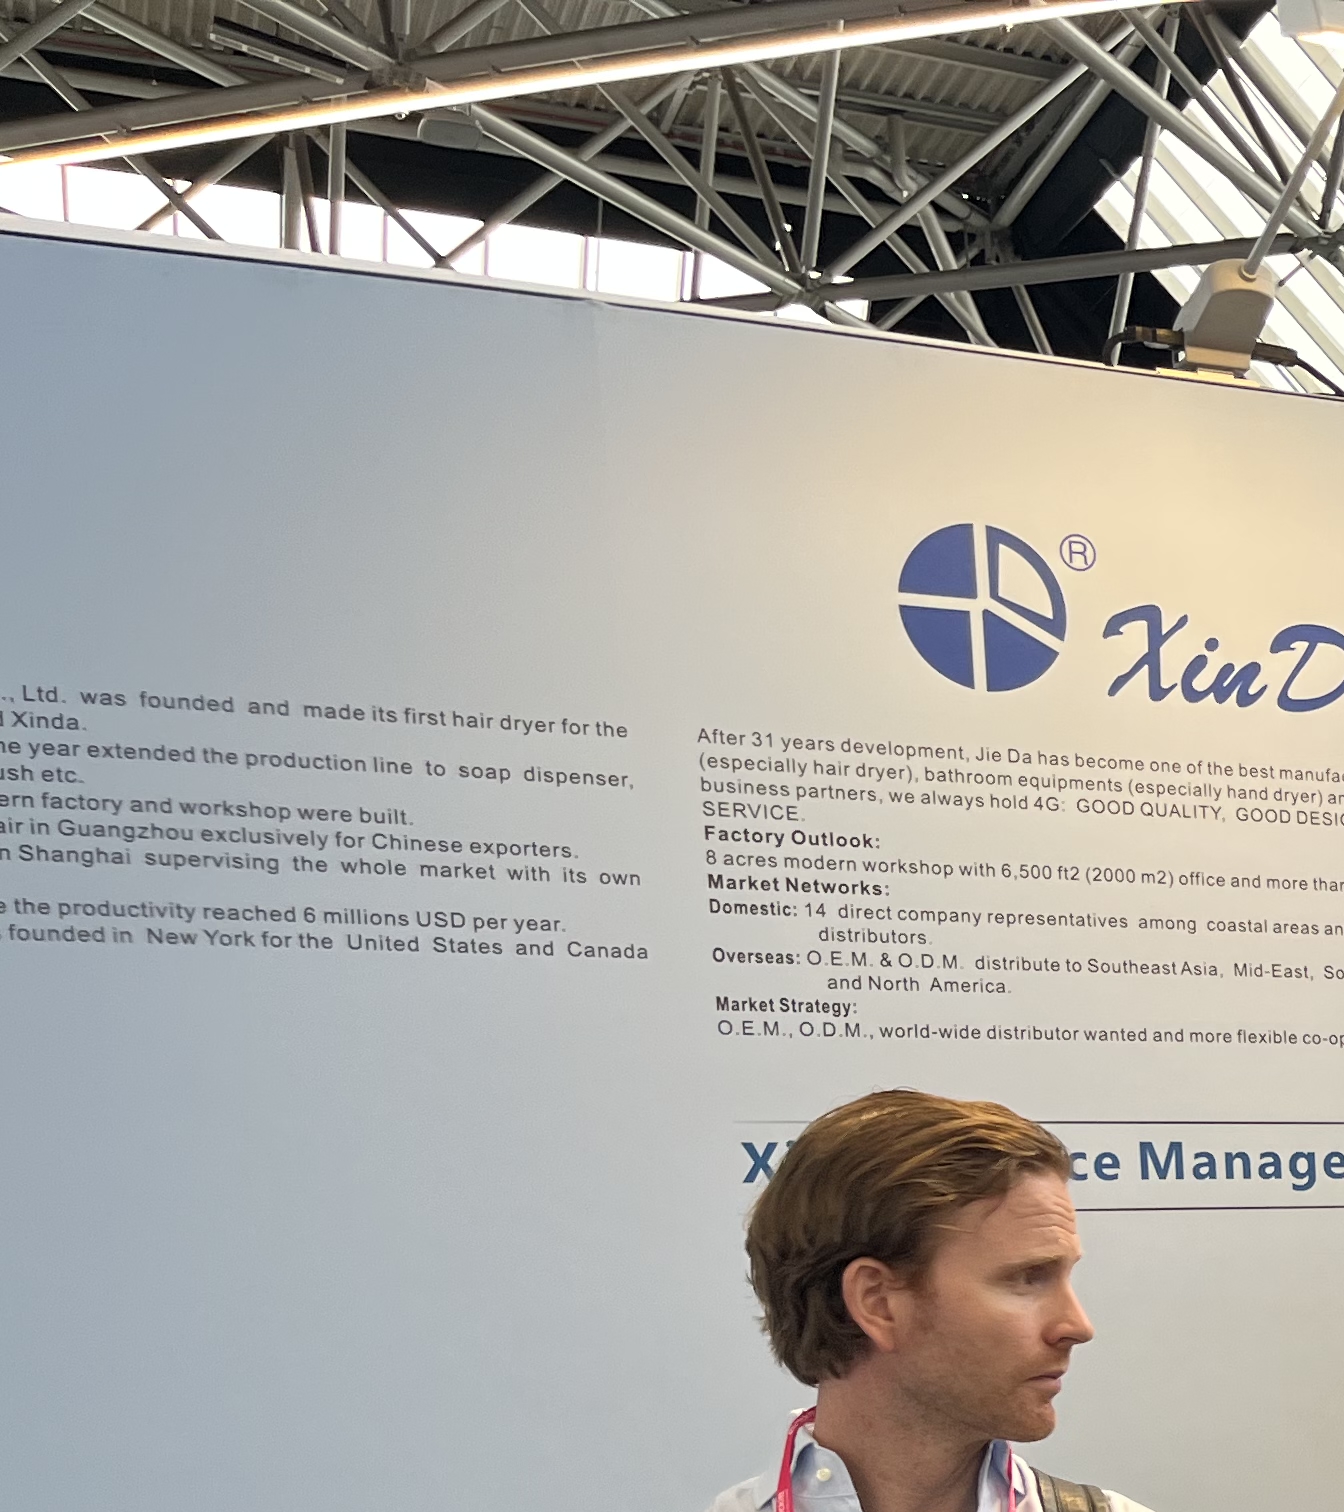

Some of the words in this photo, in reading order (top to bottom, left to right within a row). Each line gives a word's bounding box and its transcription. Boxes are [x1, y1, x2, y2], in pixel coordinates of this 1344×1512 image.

[10, 710, 87, 730] Xinda.
[21, 684, 66, 704] Ltd.
[79, 691, 127, 707] was
[139, 690, 235, 713] founded
[247, 700, 290, 717] and
[302, 704, 366, 721] made
[371, 705, 398, 723] its
[402, 707, 447, 727] first
[452, 710, 494, 729] hair
[499, 714, 556, 736] dryer
[561, 718, 591, 736] for
[595, 721, 628, 738] the
[697, 727, 746, 746] After
[751, 731, 773, 748] 31
[780, 737, 835, 753] years
[840, 738, 970, 763] development,
[975, 746, 1002, 762] Jie
[1007, 748, 1032, 764] Da
[1037, 750, 1070, 767] has
[1074, 752, 1145, 771] become
[1149, 760, 1181, 774] one
[1186, 760, 1203, 775] of
[1207, 761, 1234, 777] the
[1238, 762, 1275, 780] best
[41, 767, 85, 784] etc.
[41, 792, 123, 816] factory
[129, 797, 173, 814] and
[178, 800, 291, 823] workshop
[296, 808, 352, 823] were
[359, 806, 414, 826] built.
[702, 800, 805, 822] SERVICE.
[29, 818, 50, 835] in
[57, 819, 193, 843] Guangzhou
[200, 827, 329, 851] exclusively
[334, 831, 365, 848] for
[372, 833, 463, 853] Chinese
[469, 841, 579, 859] exporters.
[704, 825, 785, 848] Factory
[791, 829, 880, 850] Outlook:
[706, 849, 717, 865] 8
[723, 854, 778, 868] acres
[784, 855, 857, 872] modern
[862, 858, 954, 880] workshop
[958, 861, 996, 878] with
[1001, 863, 1052, 881] 6,500
[1056, 865, 1080, 881] ft2
[1085, 866, 1136, 886] (2000
[1141, 869, 1174, 889] m2)
[1178, 871, 1226, 887] office
[1230, 874, 1261, 889] and
[1266, 878, 1308, 891] more
[707, 873, 780, 892] Market
[785, 877, 890, 897] Networks:
[13, 897, 51, 915] the
[57, 900, 196, 923] productivity
[202, 905, 296, 923] reached
[303, 906, 316, 924] 6
[323, 907, 409, 927] millions
[415, 910, 466, 928] USD
[472, 916, 508, 933] per
[513, 918, 566, 935] year.
[818, 926, 932, 945] distributors.
[715, 995, 775, 1013] Market
[779, 997, 857, 1018] Strategy:
[717, 1019, 793, 1039] O.E.M.,
[799, 1021, 874, 1040] O.D.M.,
[878, 1023, 981, 1040] world-wide
[986, 1024, 1080, 1041] distributor
[1083, 1027, 1147, 1042] wanted
[1152, 1028, 1184, 1043] and
[1189, 1031, 1232, 1044] more
[1236, 1029, 1298, 1045] flexible
[1069, 1150, 1121, 1181] ce
